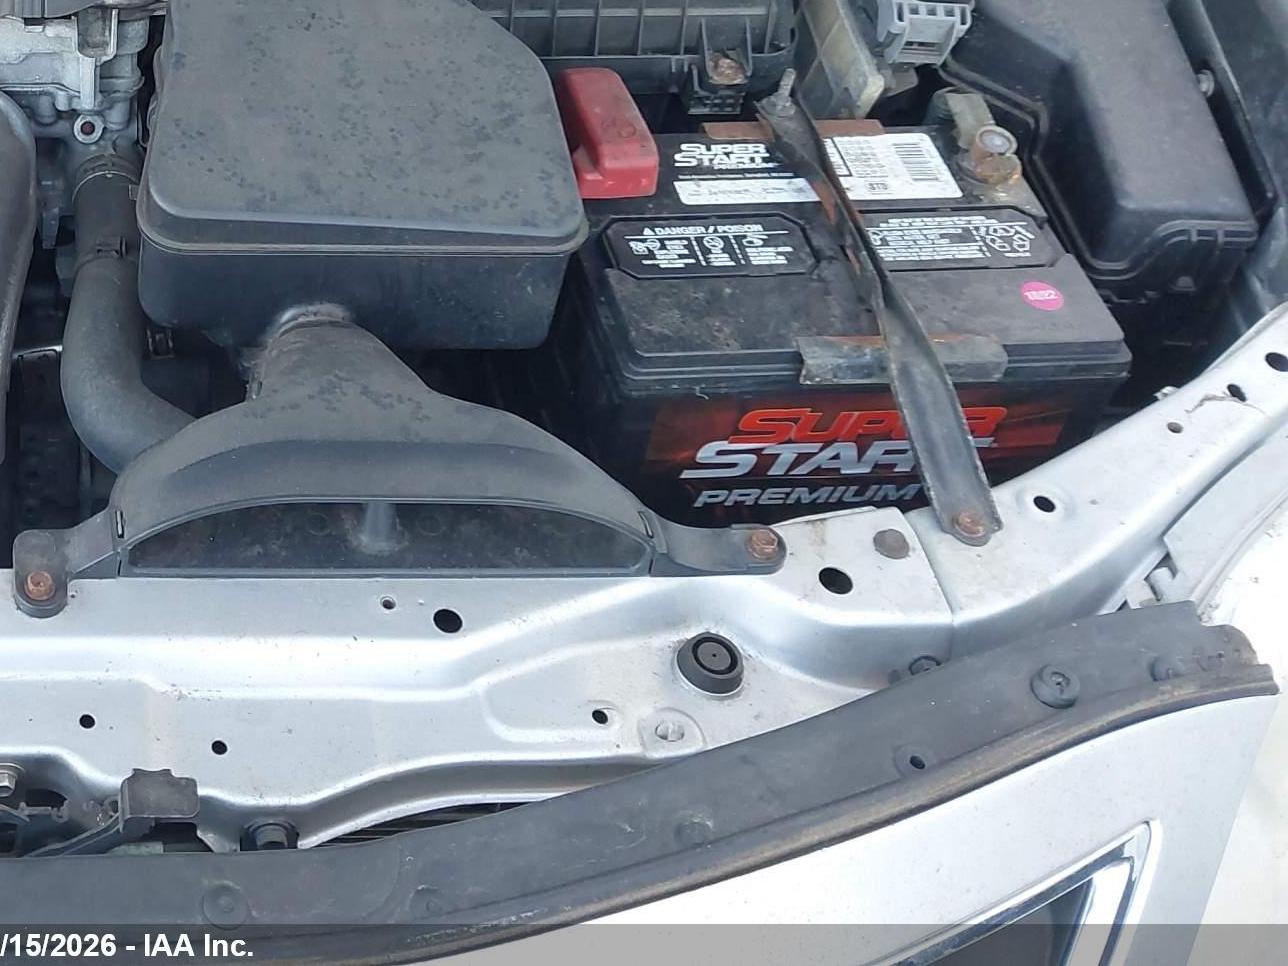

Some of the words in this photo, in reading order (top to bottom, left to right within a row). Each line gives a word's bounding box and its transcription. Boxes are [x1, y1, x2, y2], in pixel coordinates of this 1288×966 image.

[679, 143, 767, 155] SUPER
[673, 153, 771, 167] START
[654, 225, 706, 235] DANGER
[717, 224, 764, 233] POISON
[727, 407, 1008, 445] SUPR
[679, 436, 996, 479] STAR
[693, 483, 922, 508] PREMIUM
